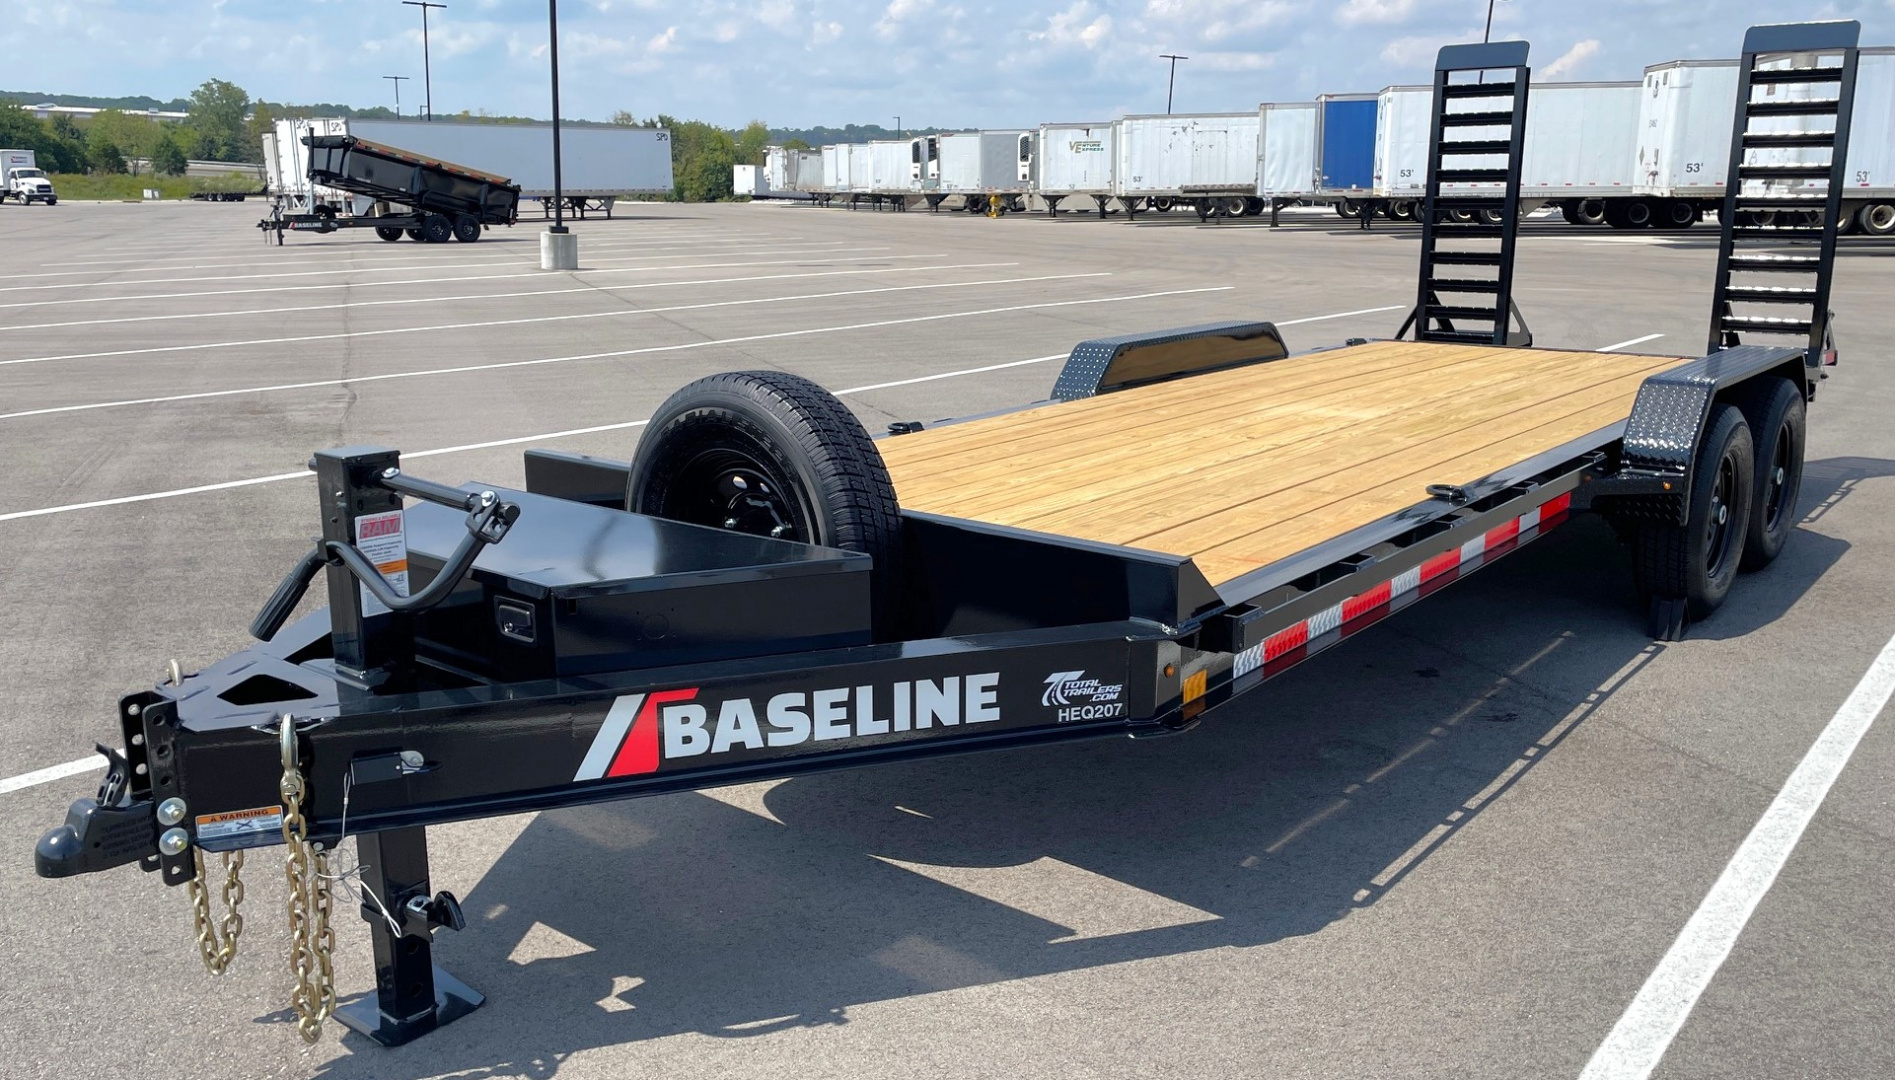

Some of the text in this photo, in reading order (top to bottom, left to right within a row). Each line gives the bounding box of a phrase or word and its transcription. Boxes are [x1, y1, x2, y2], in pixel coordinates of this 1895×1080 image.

[360, 518, 400, 538] RAM
[1063, 684, 1123, 697] TRAILERS
[1064, 679, 1101, 689] TOTAL
[663, 672, 1000, 759] BASELINE
[1059, 703, 1123, 722] HEQ207
[220, 809, 269, 821] WARNING
